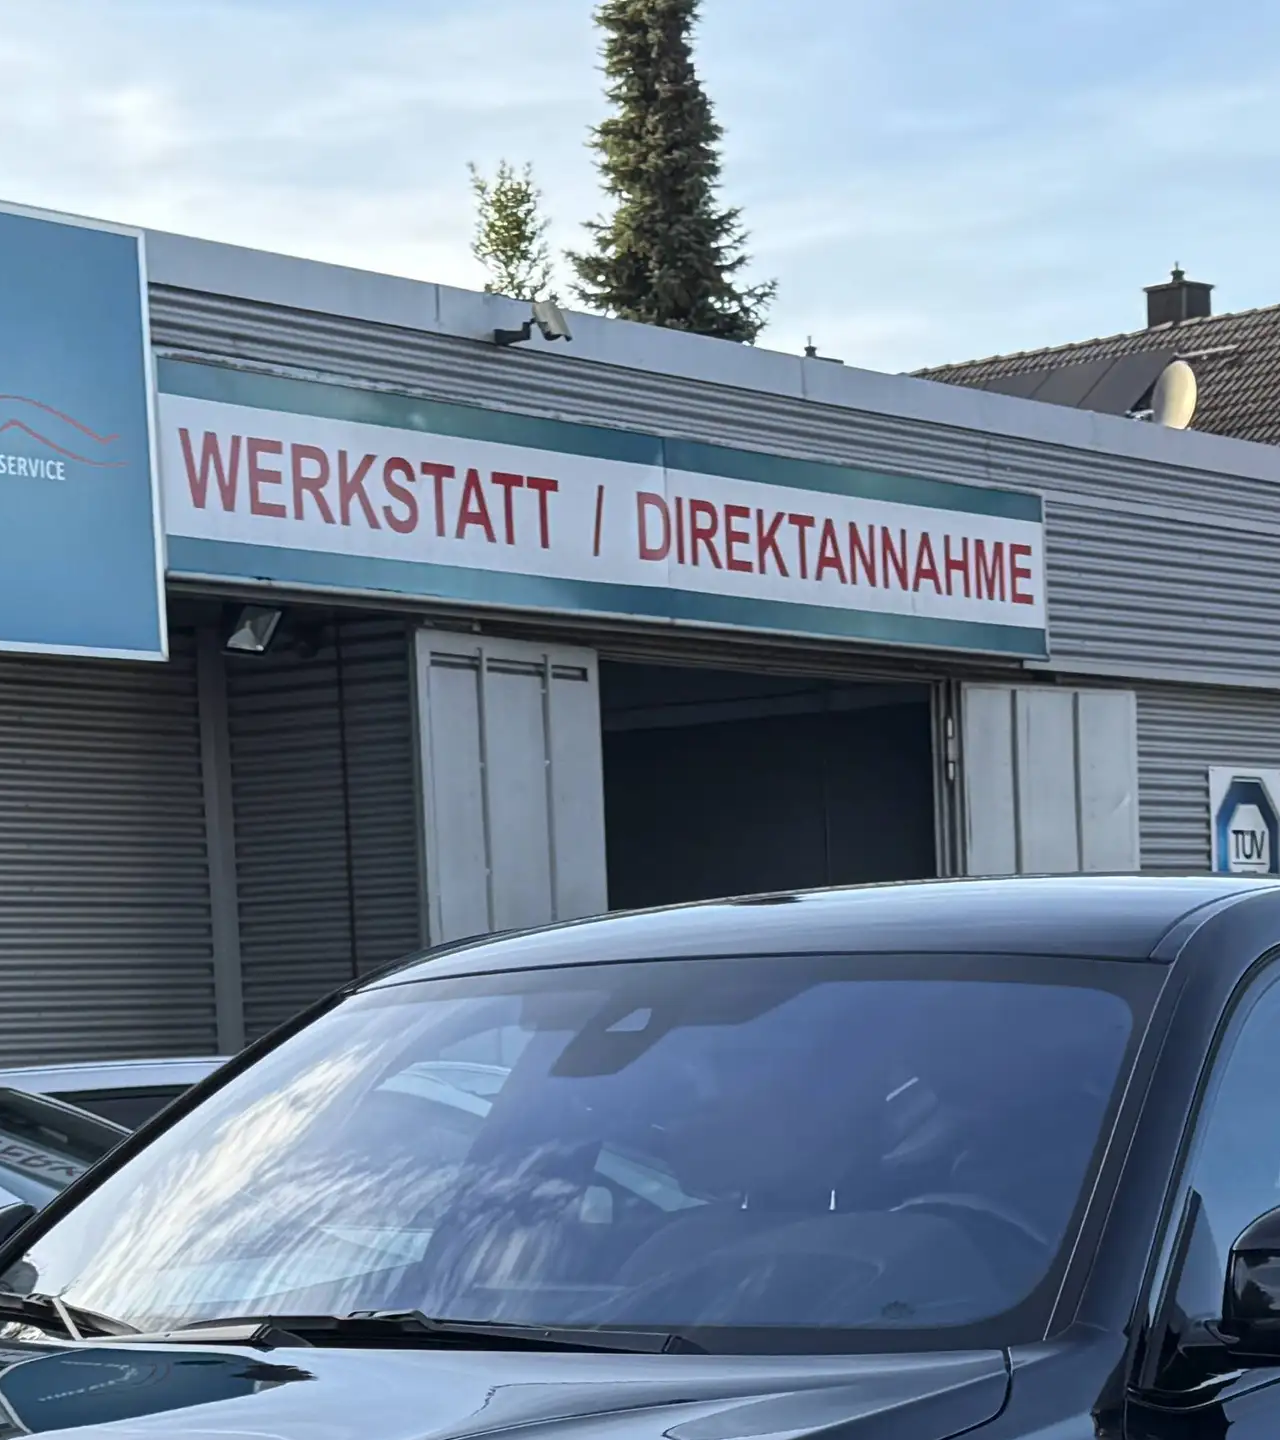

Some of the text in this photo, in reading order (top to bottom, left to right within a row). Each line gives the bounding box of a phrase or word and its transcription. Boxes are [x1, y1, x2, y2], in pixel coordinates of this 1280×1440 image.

[178, 427, 1034, 606] WERKSTATT / DIREKTANNAHME
[1231, 829, 1266, 860] TÜV
